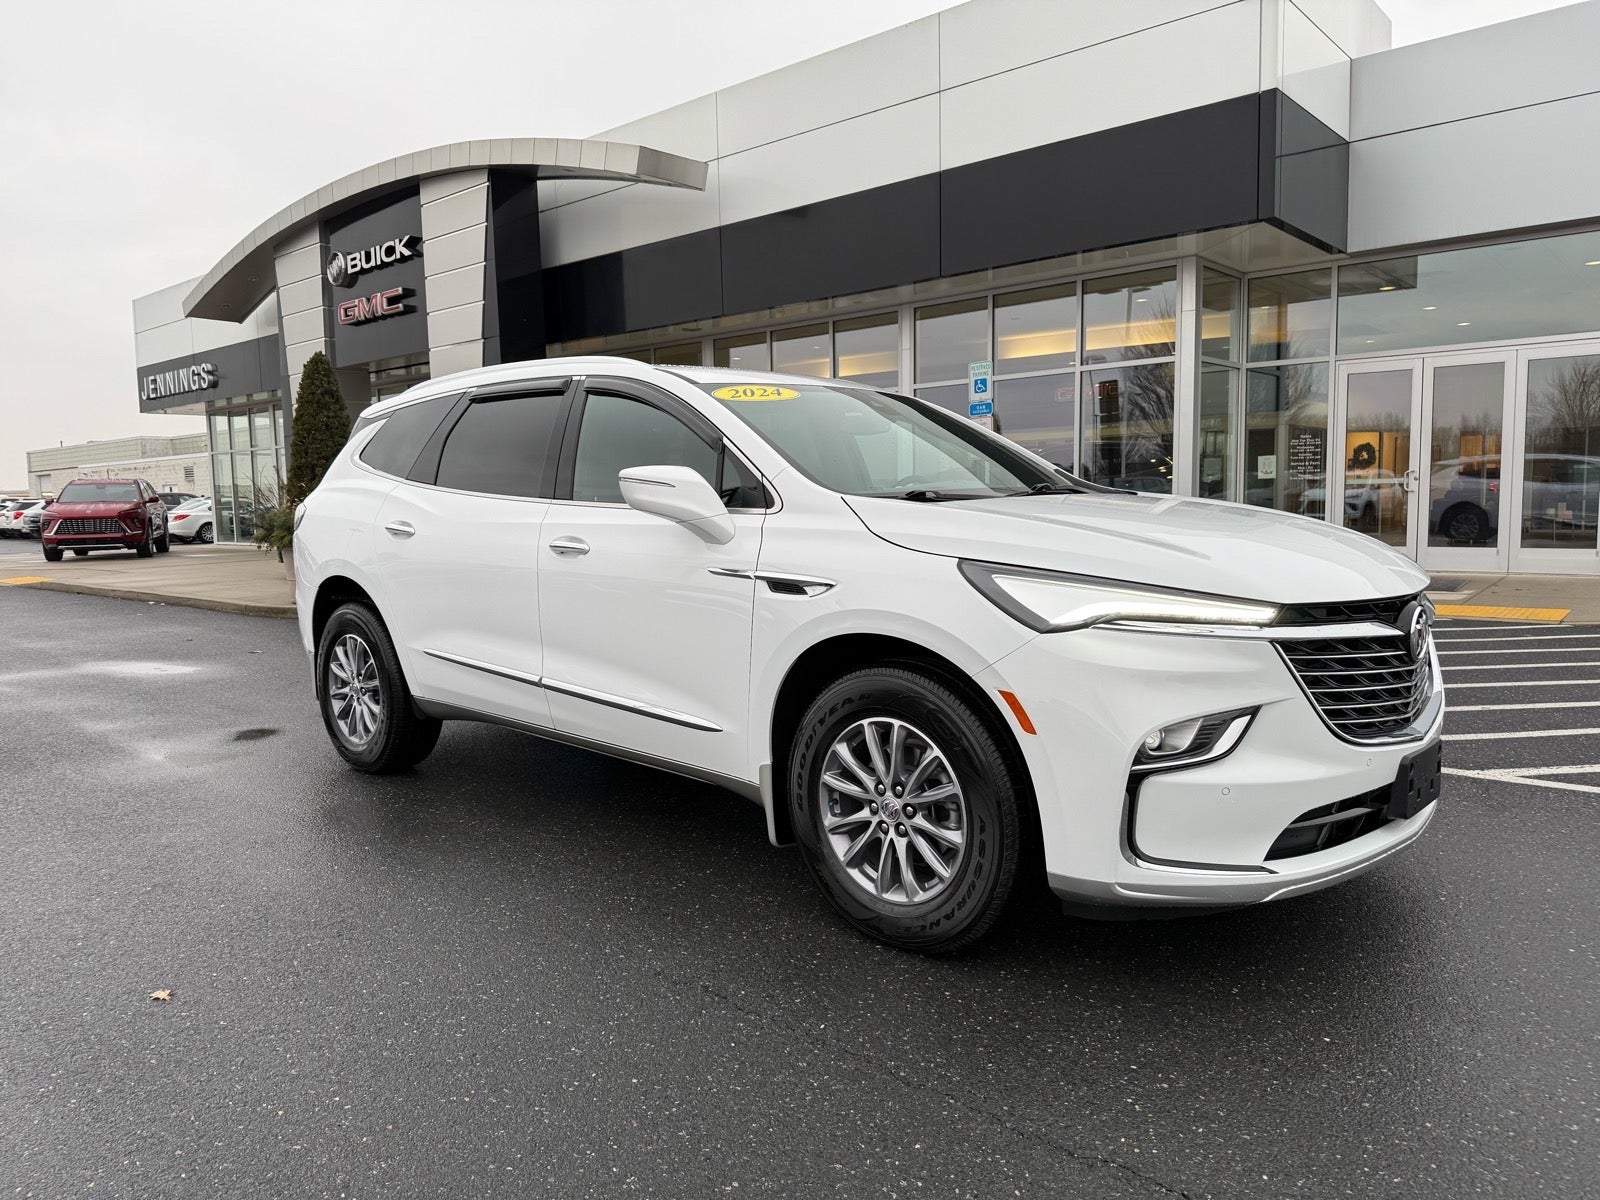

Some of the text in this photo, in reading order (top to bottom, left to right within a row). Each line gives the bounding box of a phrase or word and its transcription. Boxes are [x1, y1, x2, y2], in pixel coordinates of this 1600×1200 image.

[346, 235, 412, 274] BUICK
[338, 287, 404, 324] GMC
[141, 363, 209, 401] JENNINGS
[727, 387, 783, 399] 2024
[797, 693, 872, 811] GOODYEAR
[900, 813, 987, 935] ASSURANCE
